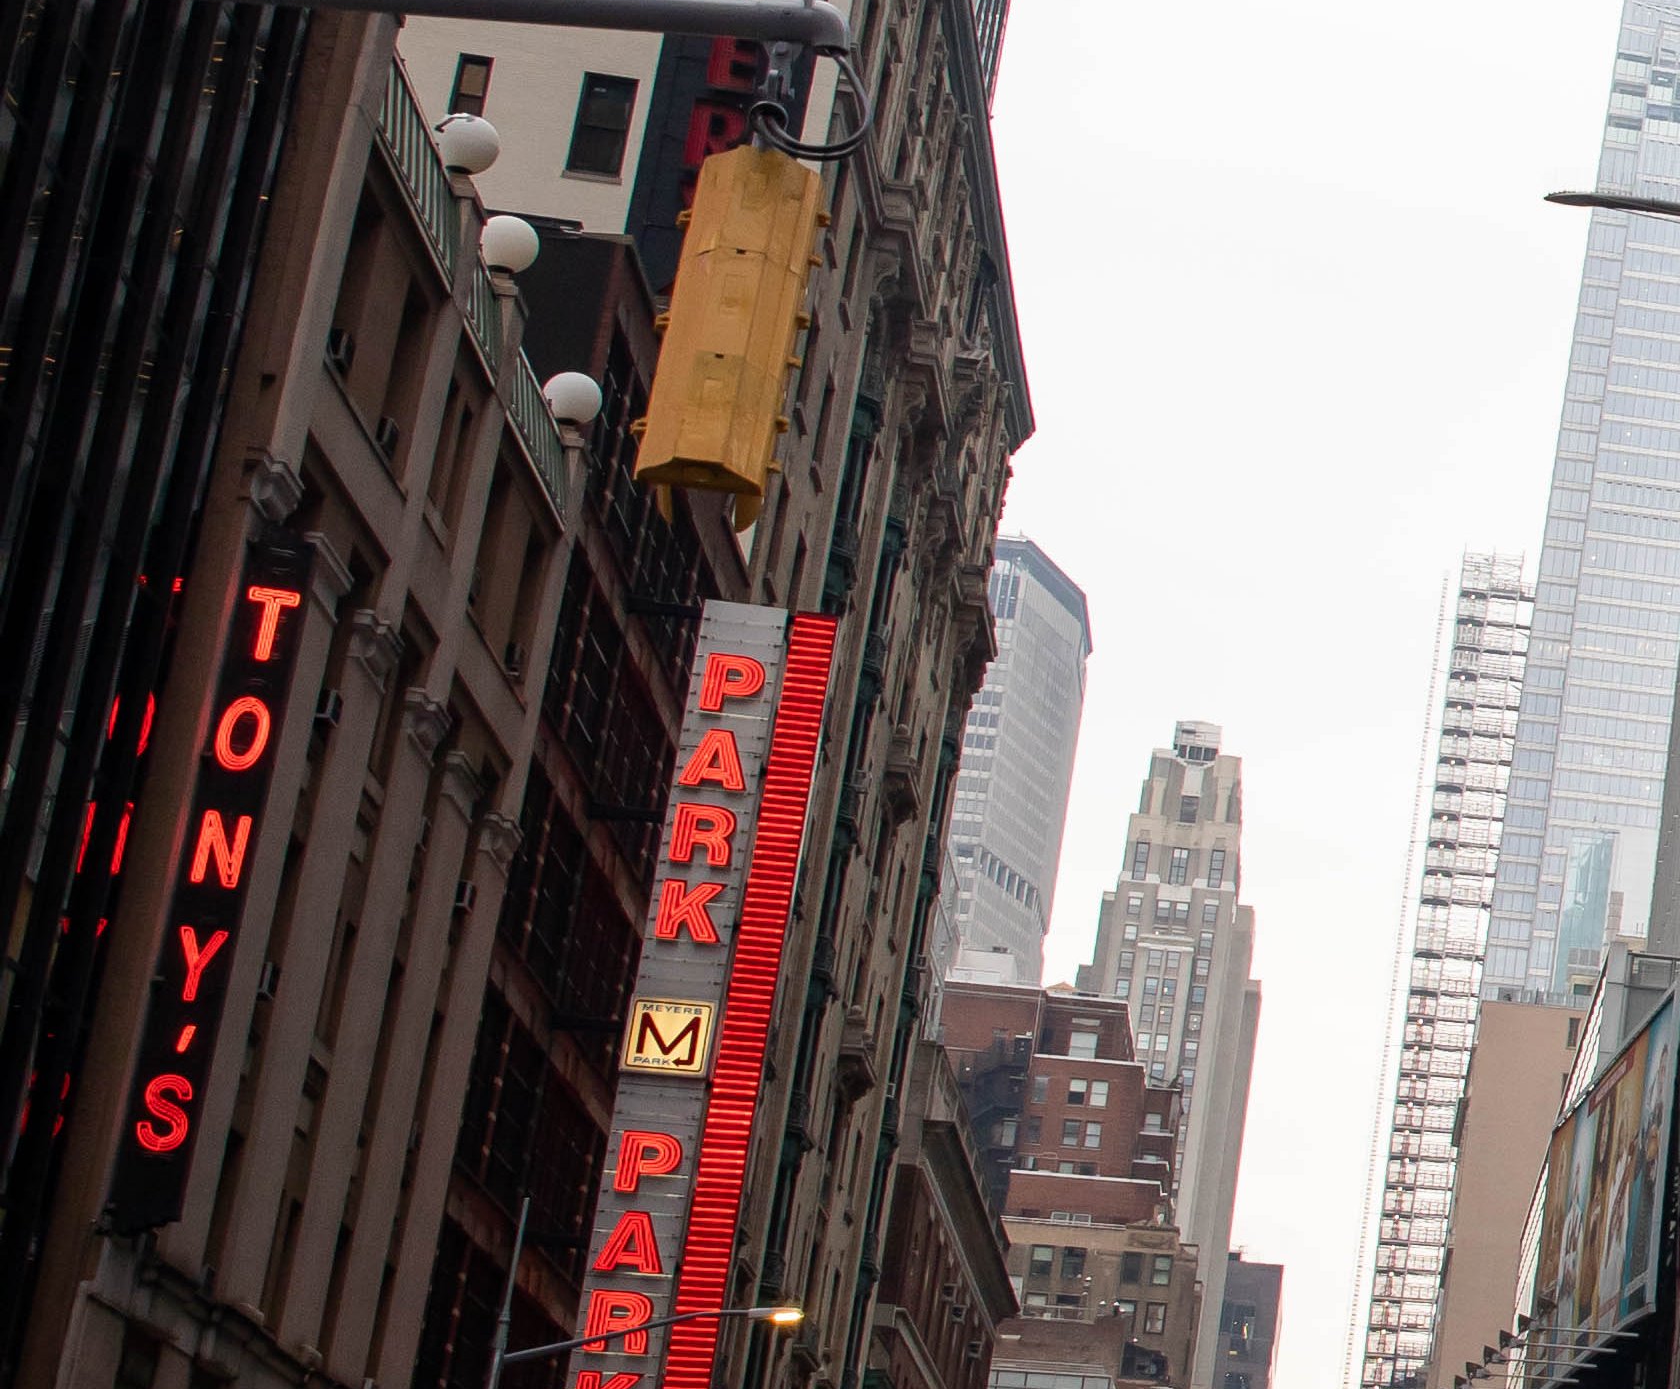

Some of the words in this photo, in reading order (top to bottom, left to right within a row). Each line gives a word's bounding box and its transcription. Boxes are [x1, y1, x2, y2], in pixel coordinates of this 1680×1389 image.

[136, 586, 300, 1152] TONY'S
[655, 653, 766, 944] PARK
[632, 1055, 672, 1067] PARK
[642, 1003, 703, 1016] MEYERS
